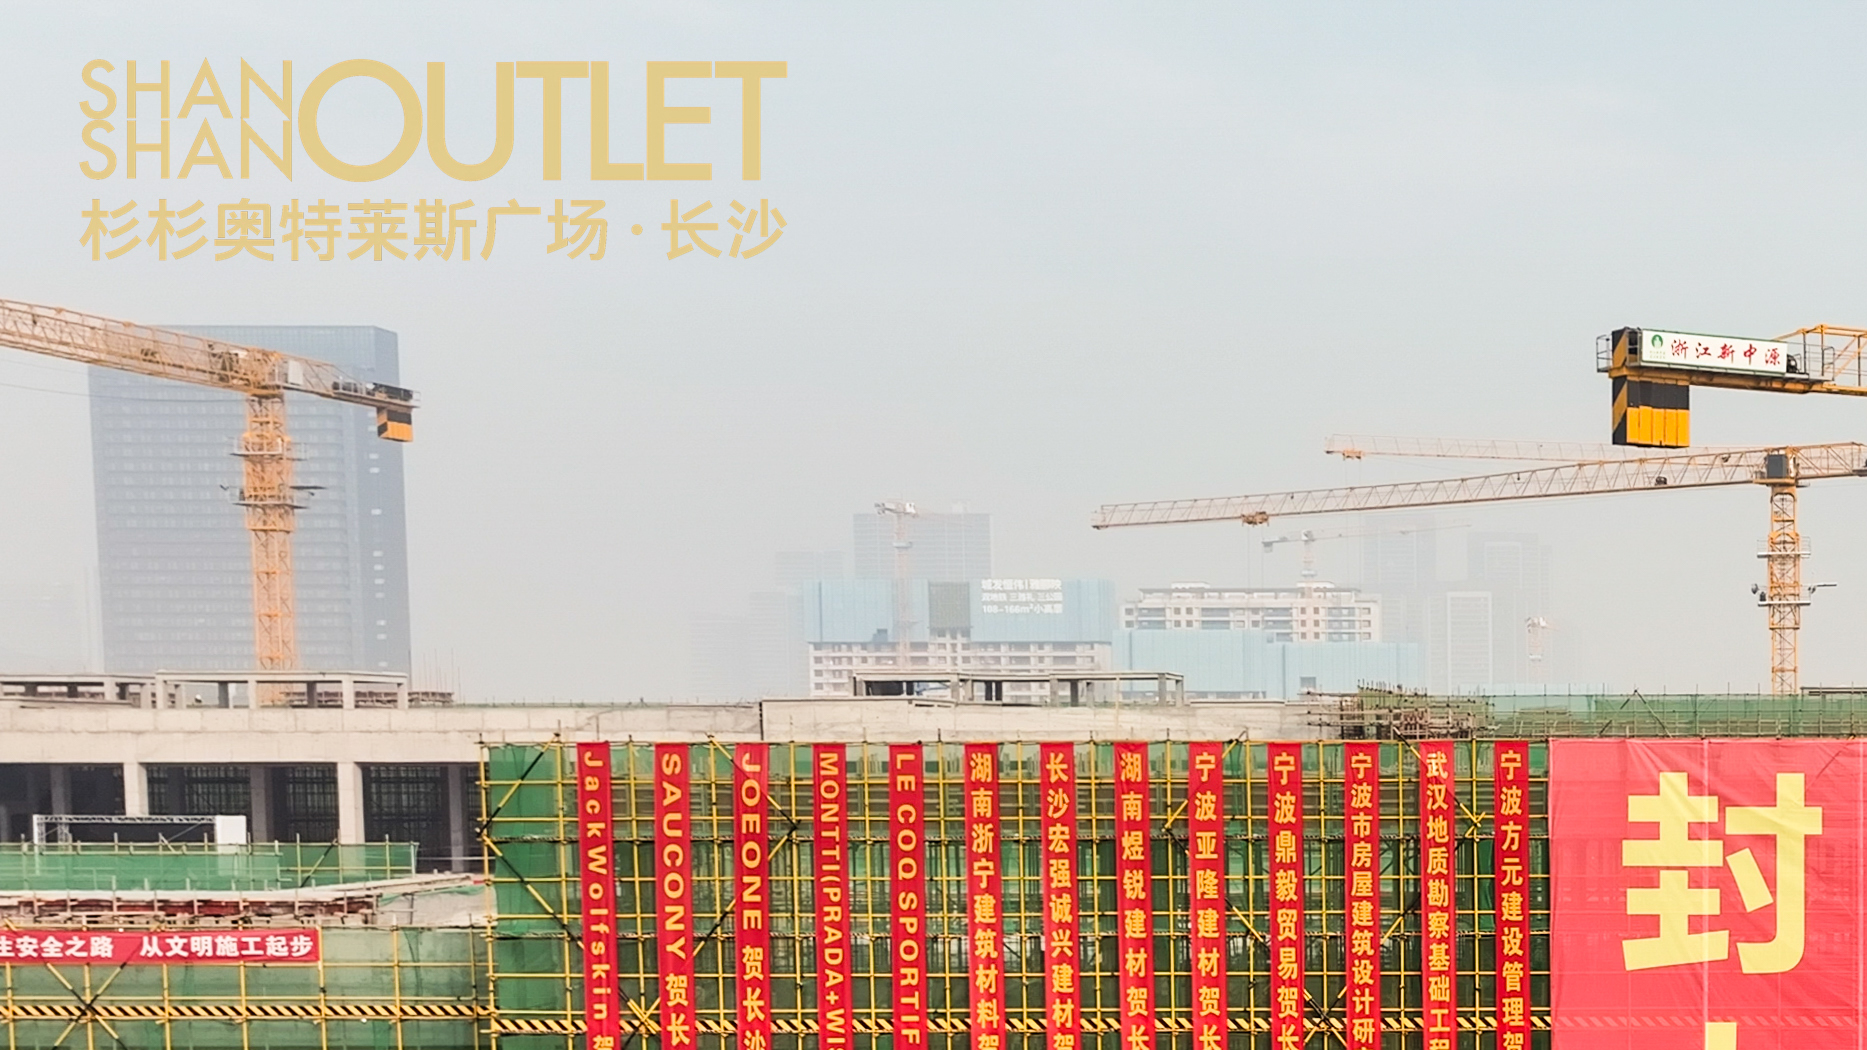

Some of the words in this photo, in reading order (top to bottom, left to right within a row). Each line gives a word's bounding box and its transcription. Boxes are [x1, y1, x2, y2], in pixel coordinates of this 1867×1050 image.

[1671, 339, 1780, 366] 浙江新中源
[896, 754, 916, 792] LE
[584, 751, 612, 1020] JackWolfskin
[662, 753, 686, 959] SAUCONY
[741, 752, 762, 930] JOEONE
[897, 804, 917, 881] COQ
[140, 935, 313, 957] 从文明施工起步
[898, 891, 920, 1044] SPORTIF
